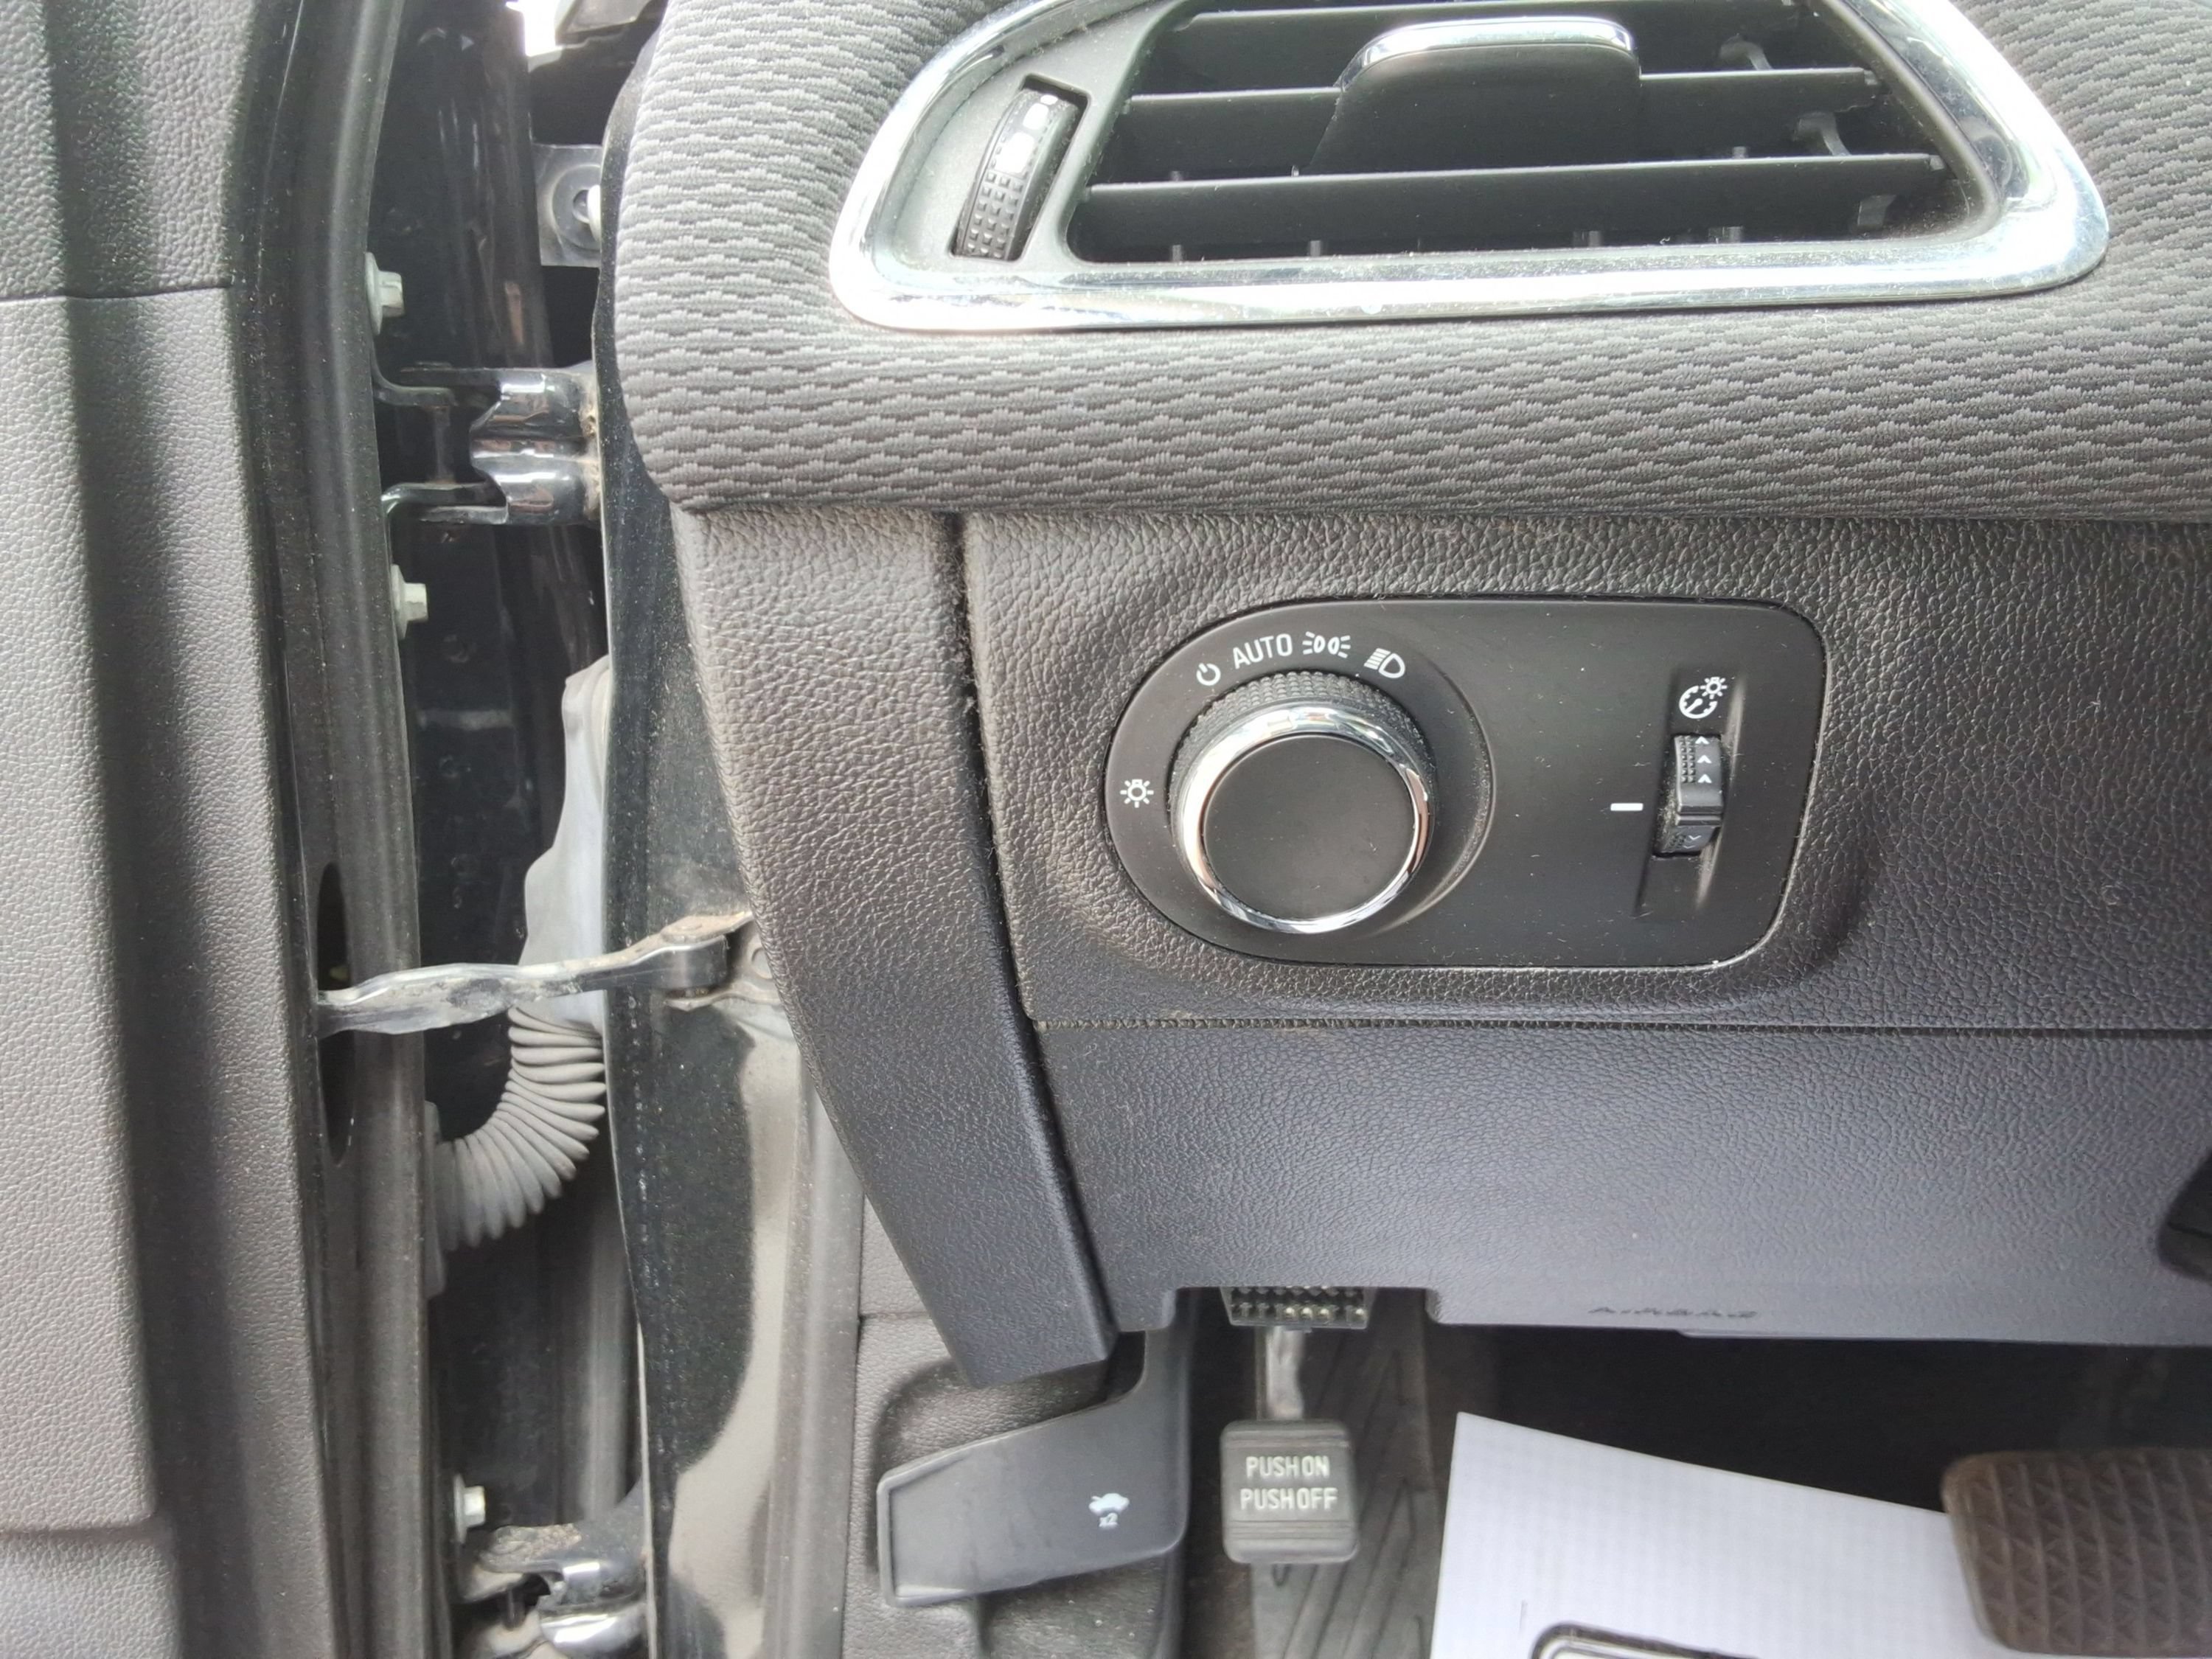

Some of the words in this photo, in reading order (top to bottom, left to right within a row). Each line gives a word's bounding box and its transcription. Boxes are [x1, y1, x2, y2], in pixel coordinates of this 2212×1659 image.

[1232, 633, 1293, 669] AUTO
[1245, 1455, 1300, 1478] PUSH
[1301, 1455, 1330, 1478] ON
[1240, 1487, 1295, 1510] PUSH
[1296, 1487, 1339, 1510] OFF
